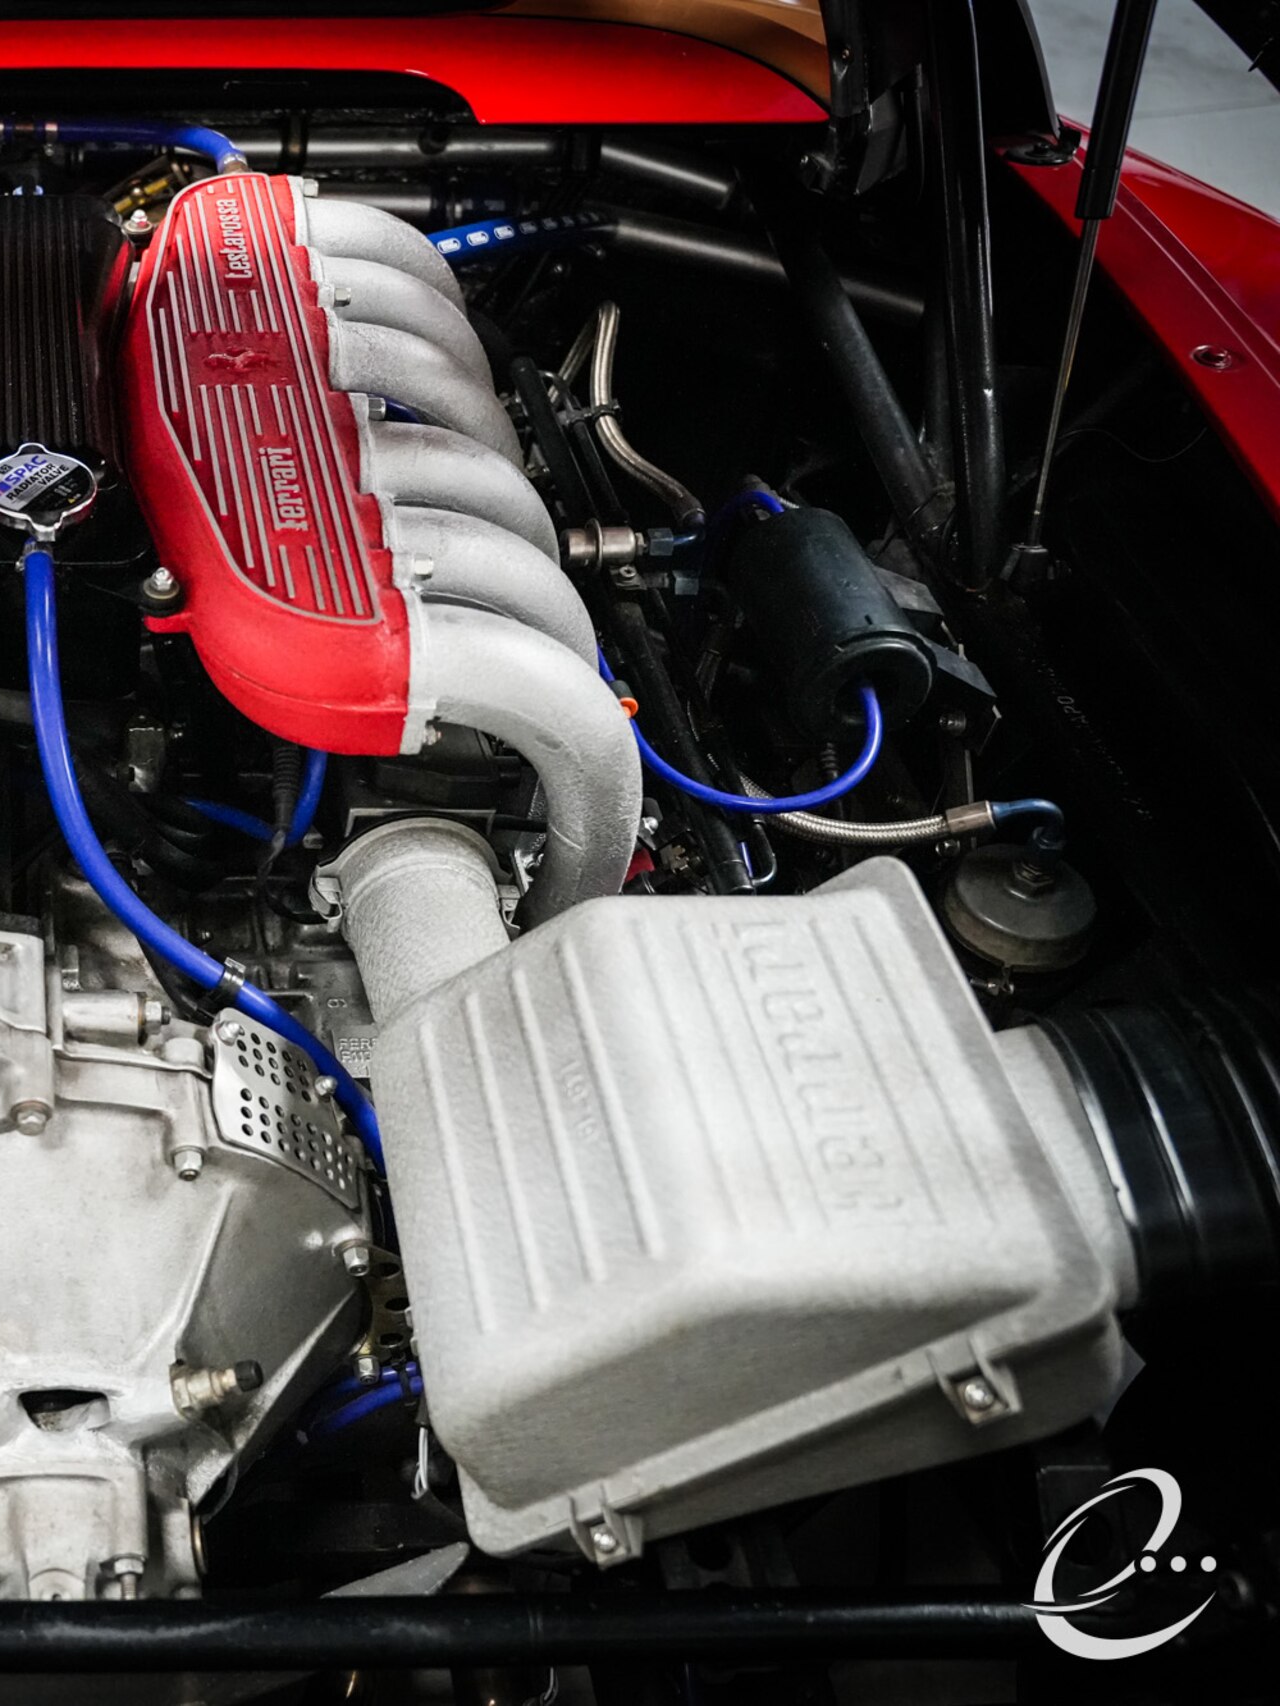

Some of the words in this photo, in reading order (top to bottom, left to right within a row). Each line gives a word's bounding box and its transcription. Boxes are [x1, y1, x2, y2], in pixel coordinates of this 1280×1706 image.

[5, 455, 47, 485] SPAC
[6, 463, 56, 501] RADIATOR
[39, 464, 70, 487] VALVE
[258, 446, 309, 532] Ferrari
